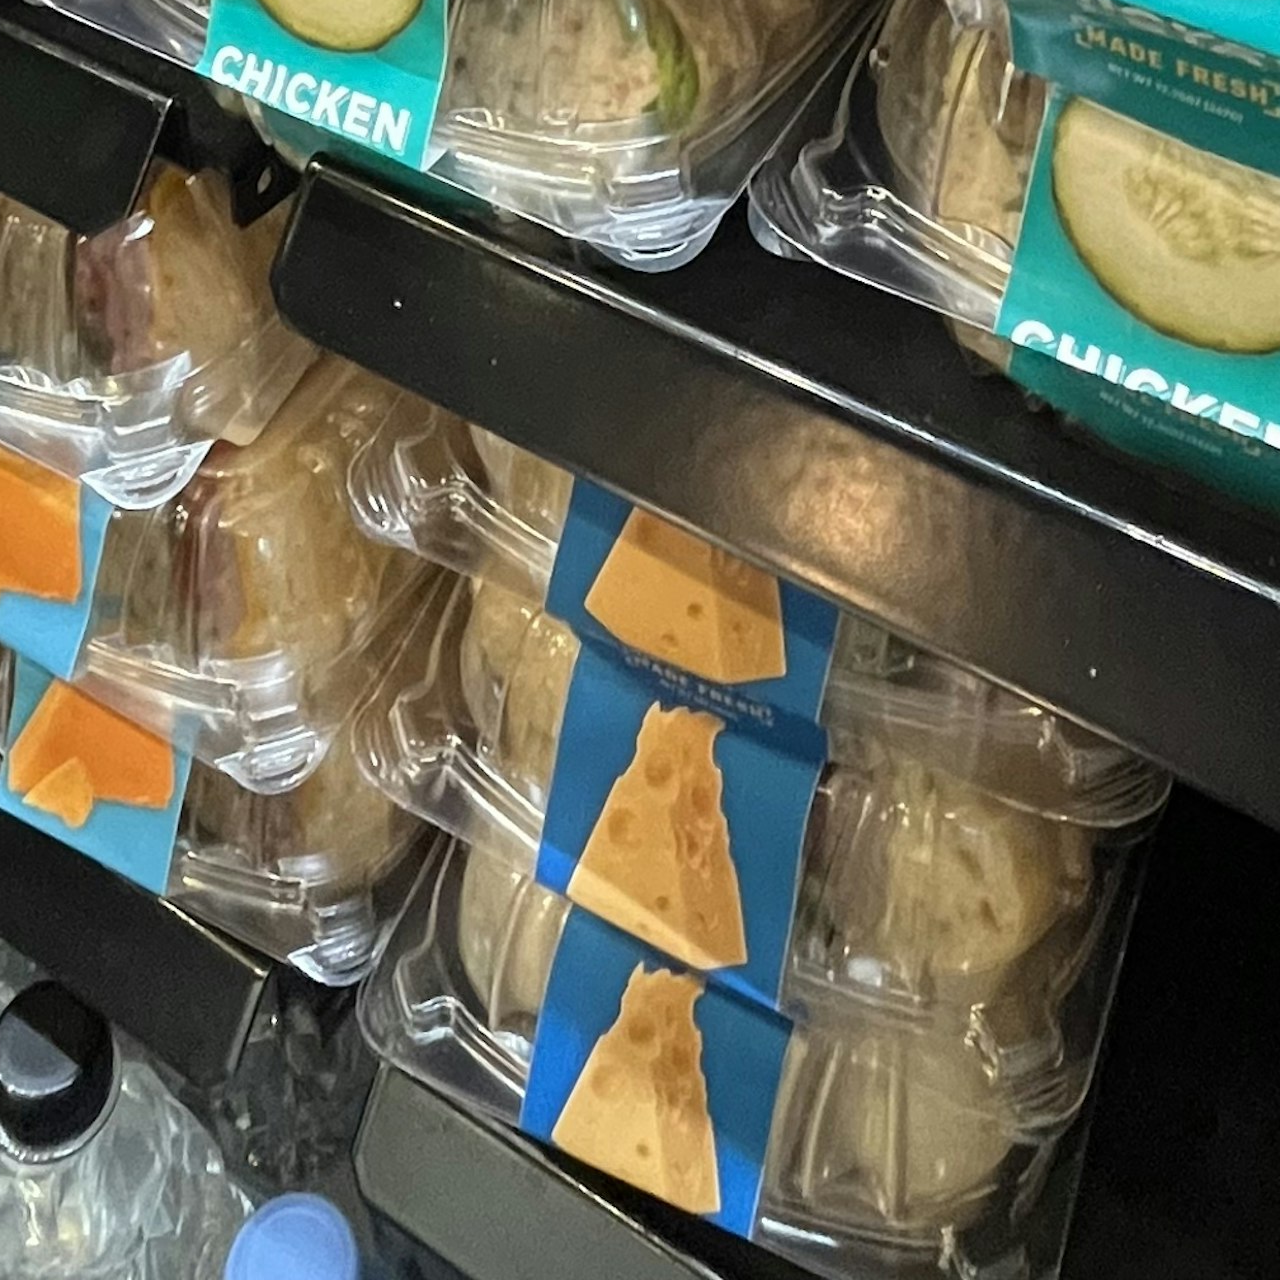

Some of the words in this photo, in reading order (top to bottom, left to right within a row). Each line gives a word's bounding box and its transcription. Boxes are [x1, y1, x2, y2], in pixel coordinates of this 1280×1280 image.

[209, 45, 414, 157] CHICKEN
[1085, 23, 1165, 71] MADE
[1174, 57, 1270, 106] FRESH
